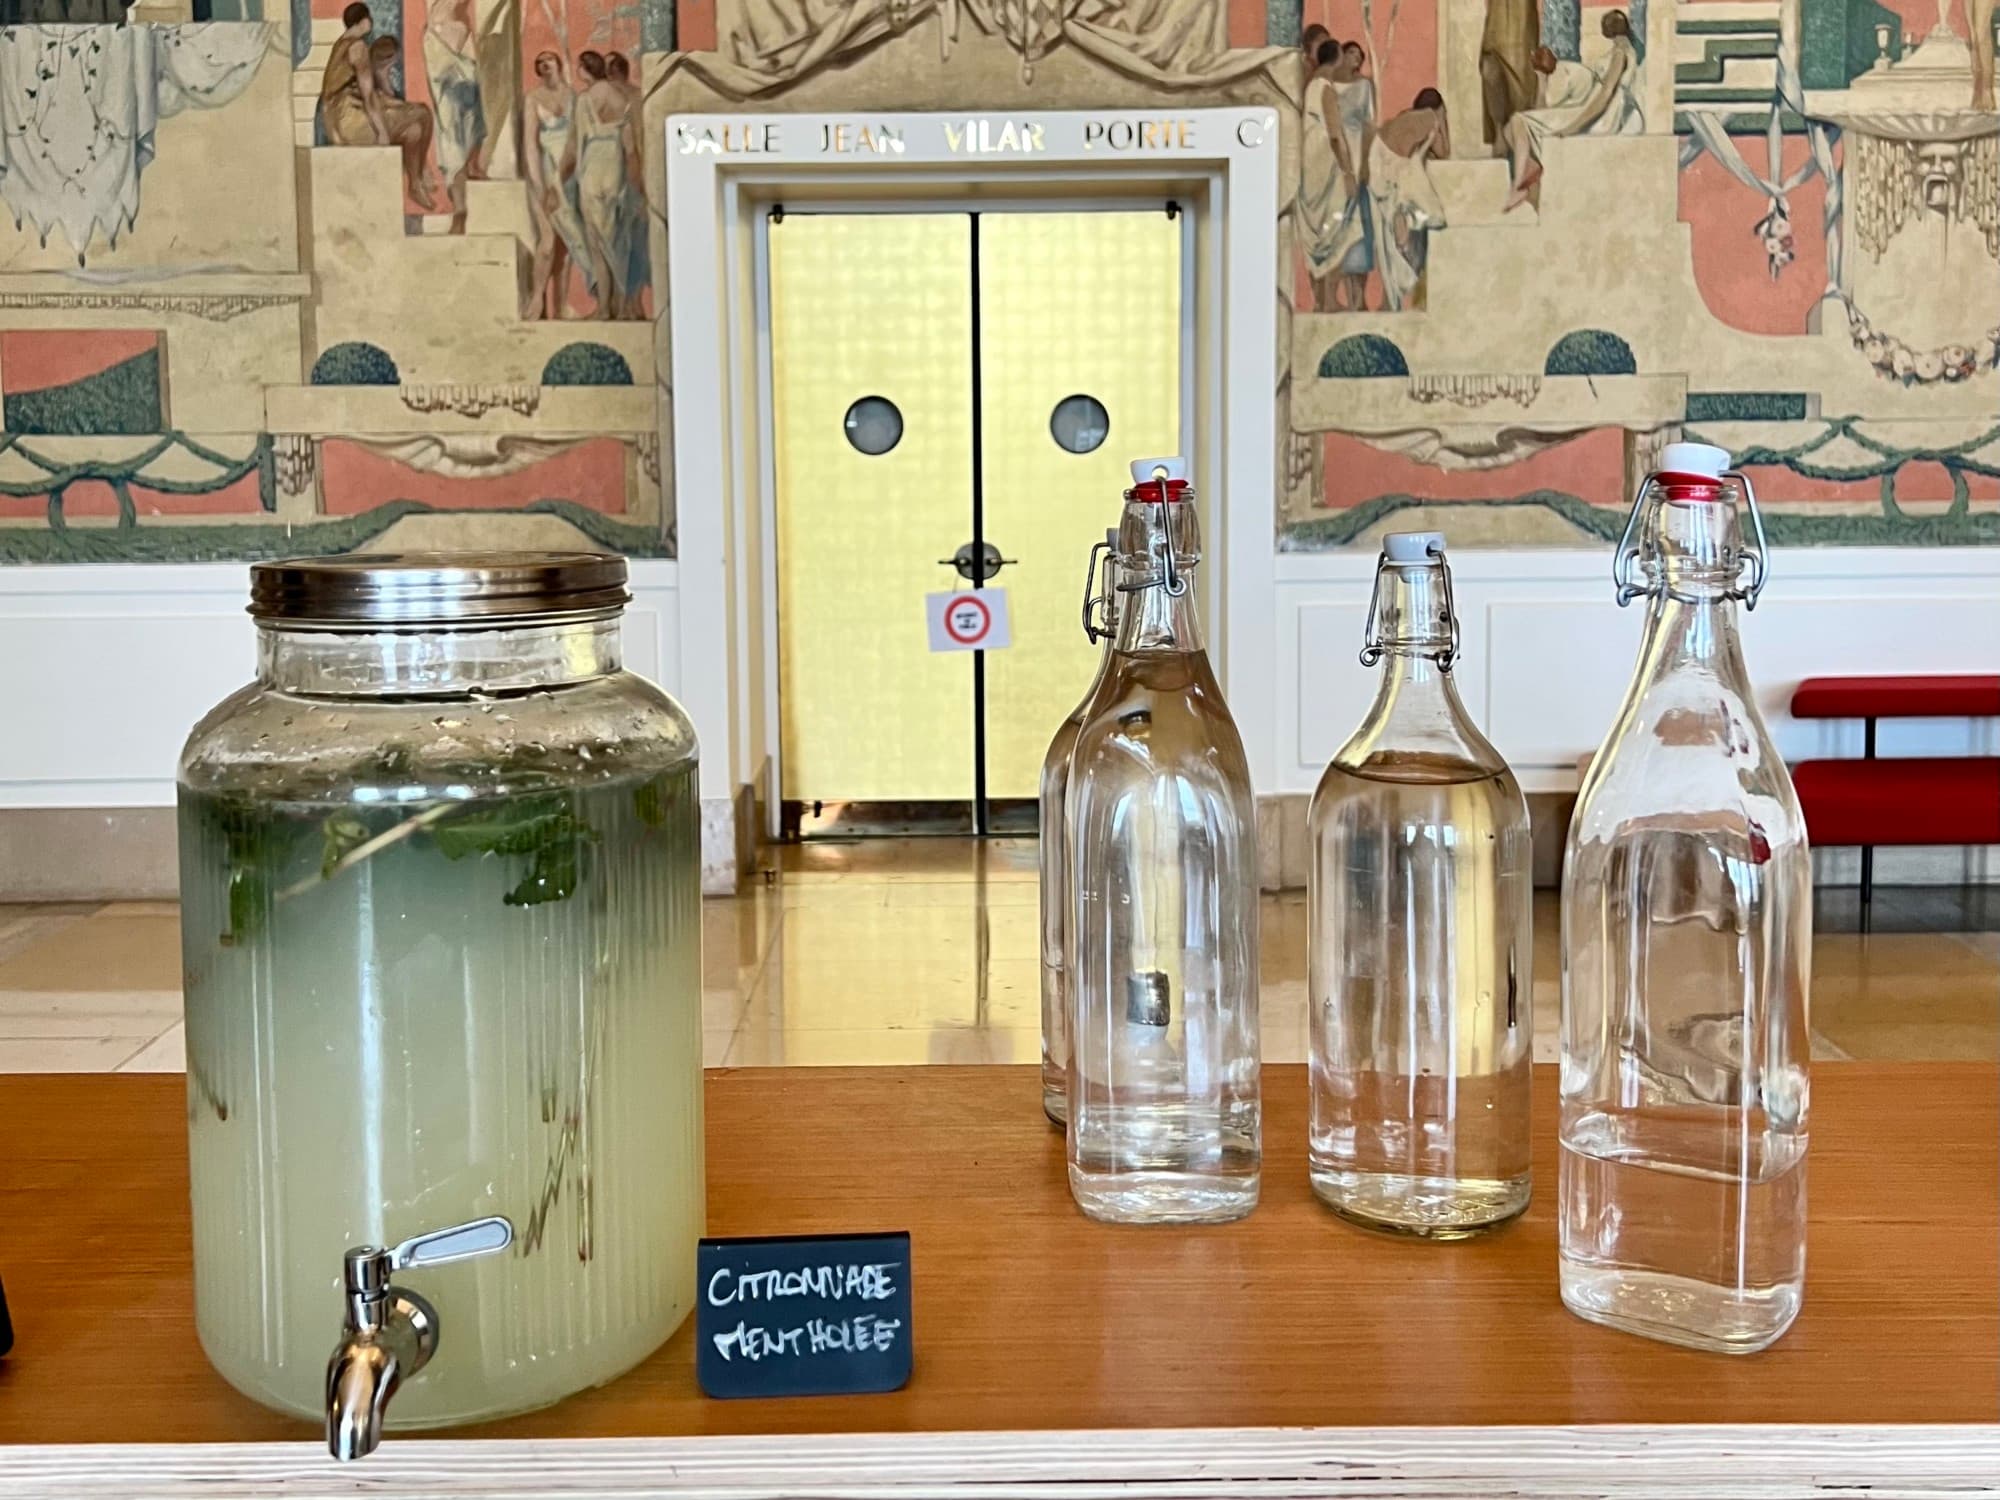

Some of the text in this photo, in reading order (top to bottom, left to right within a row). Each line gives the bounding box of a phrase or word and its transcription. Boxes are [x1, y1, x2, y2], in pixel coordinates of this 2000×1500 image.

[677, 121, 781, 155] SALLE
[821, 122, 905, 154] JEAN
[943, 119, 1046, 152] VILAR
[1084, 118, 1197, 150] PORTE
